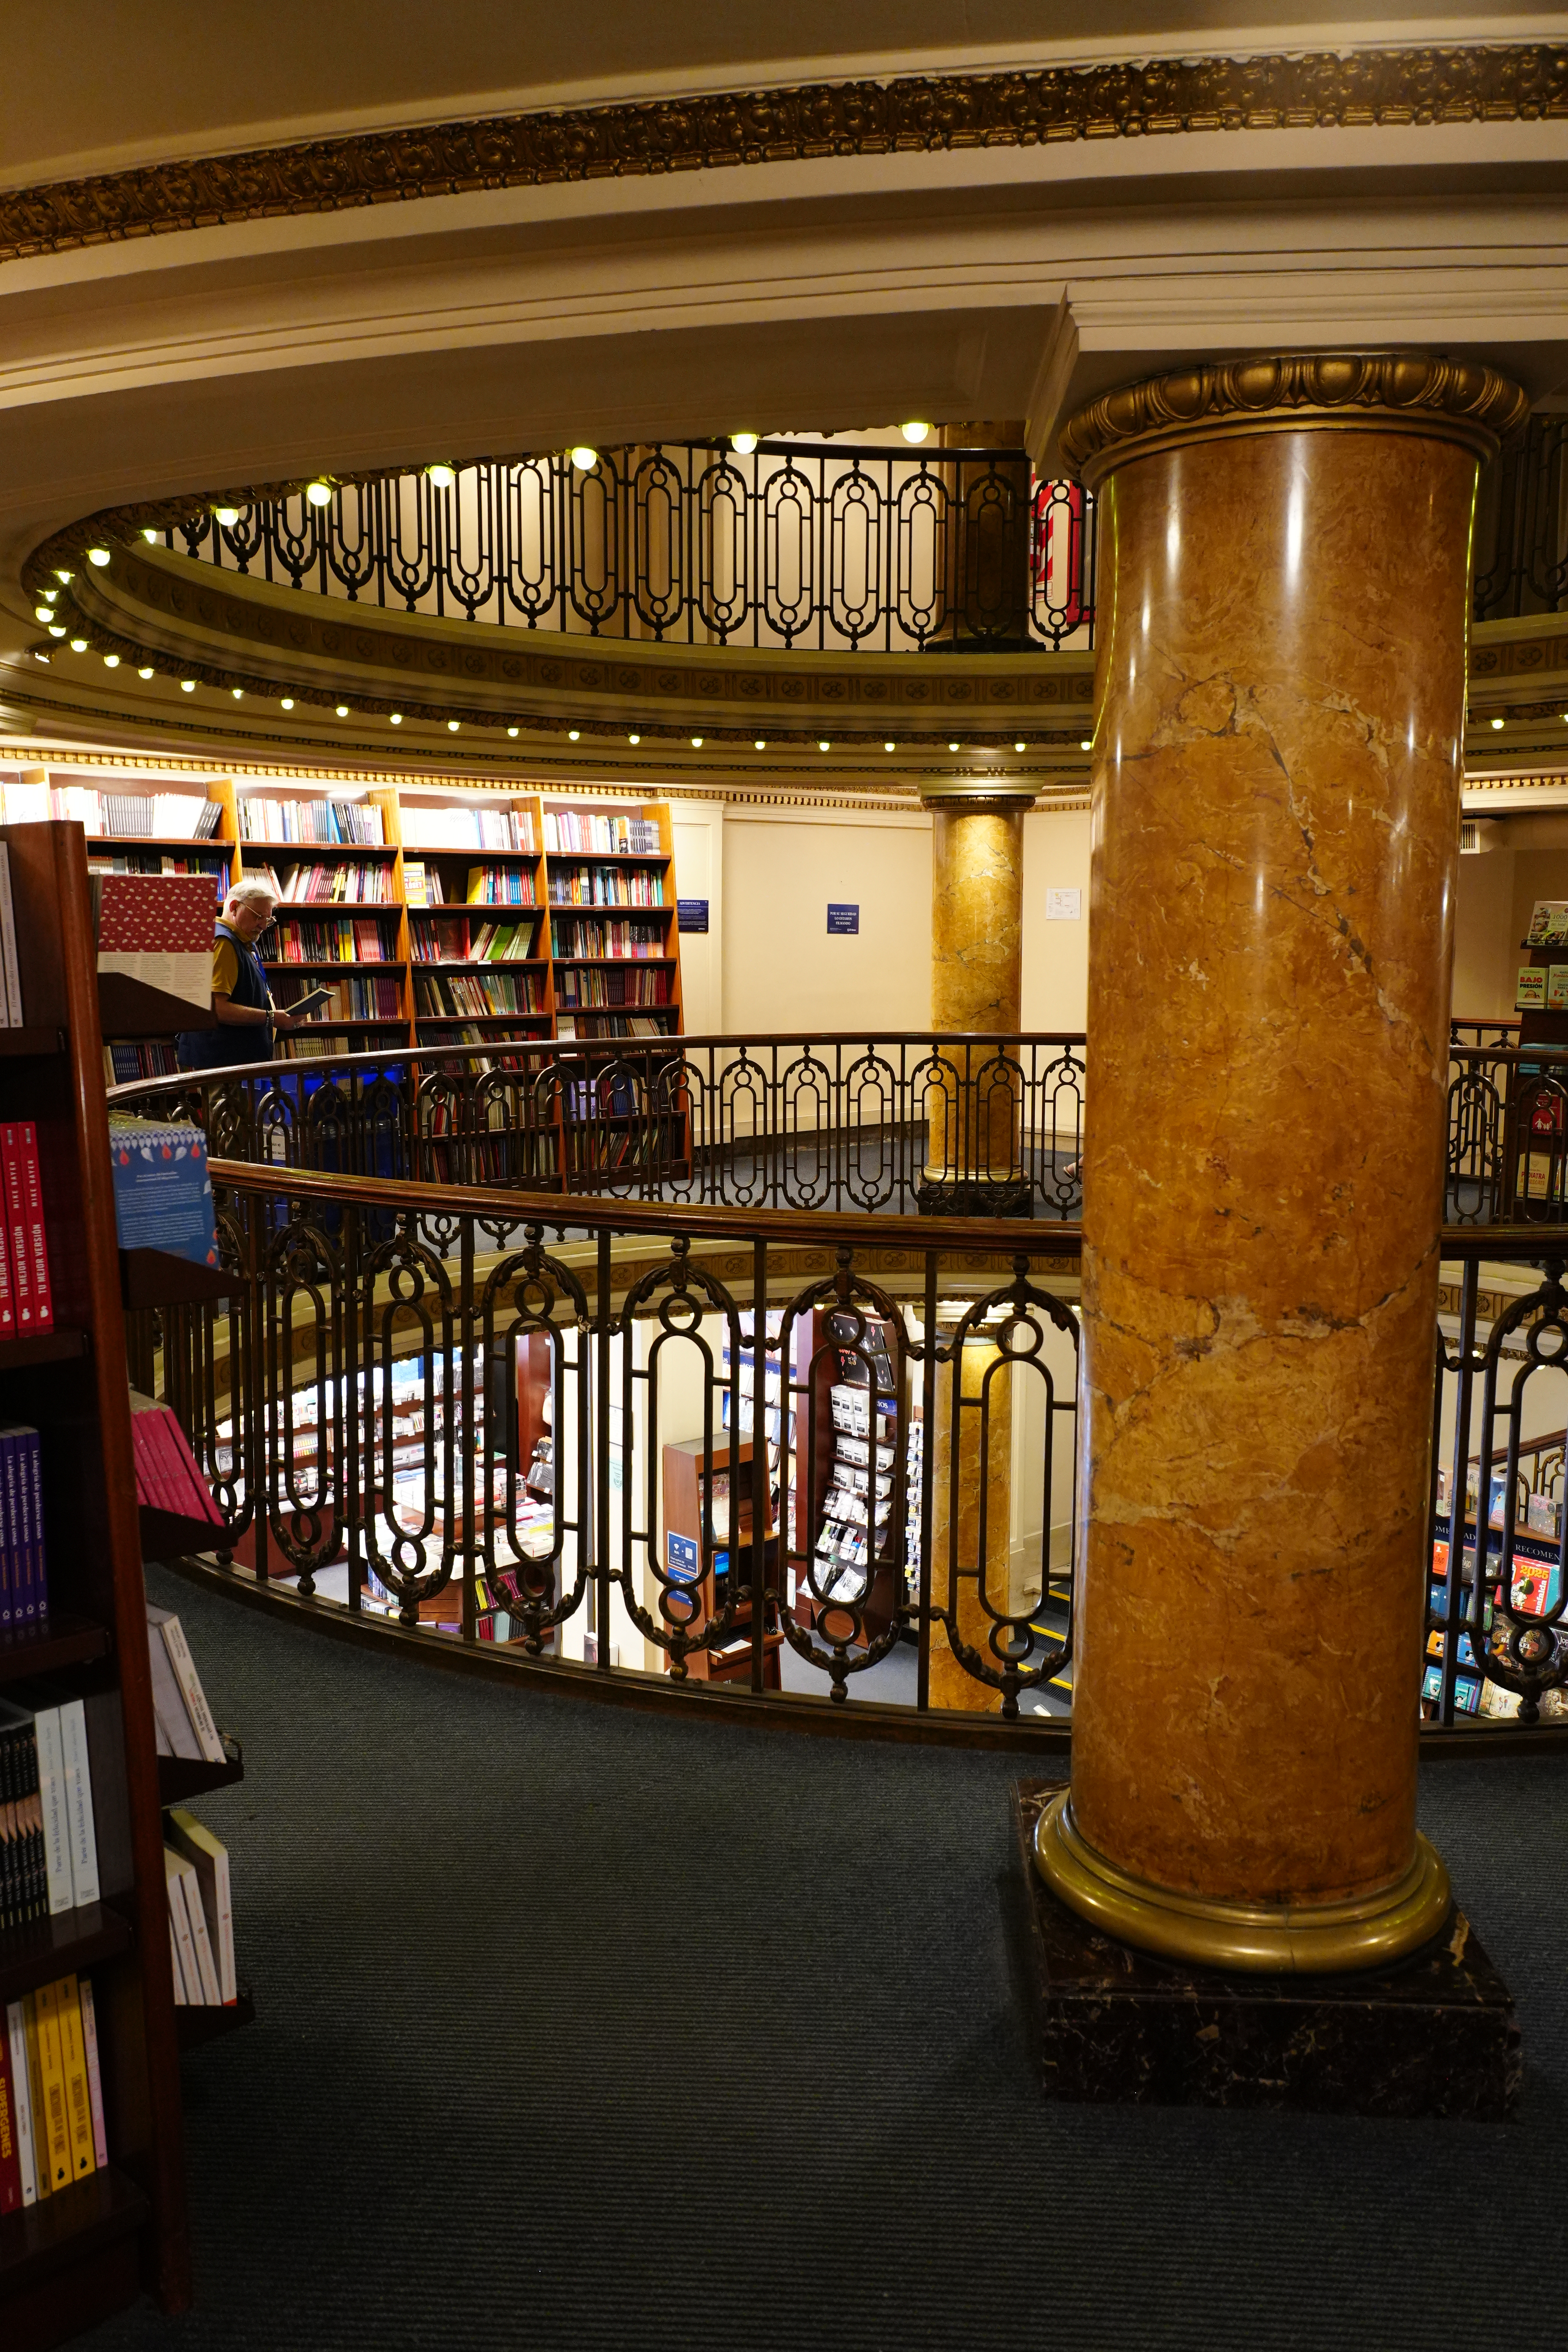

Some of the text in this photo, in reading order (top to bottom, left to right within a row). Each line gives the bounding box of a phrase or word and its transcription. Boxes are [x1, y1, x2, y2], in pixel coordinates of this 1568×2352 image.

[9, 1161, 20, 1209] MIKE BAYER
[27, 1159, 38, 1207] MIKE BAYER
[13, 1225, 28, 1296] TU MEJOR VERSIÓN
[32, 1223, 47, 1294] TU MEJOR VERSIÓN
[1516, 1544, 1560, 1560] RECOMEN
[1520, 1565, 1549, 1580] 2025
[1535, 1580, 1547, 1614] mafalda
[1501, 1636, 1531, 1650] HAKEL
